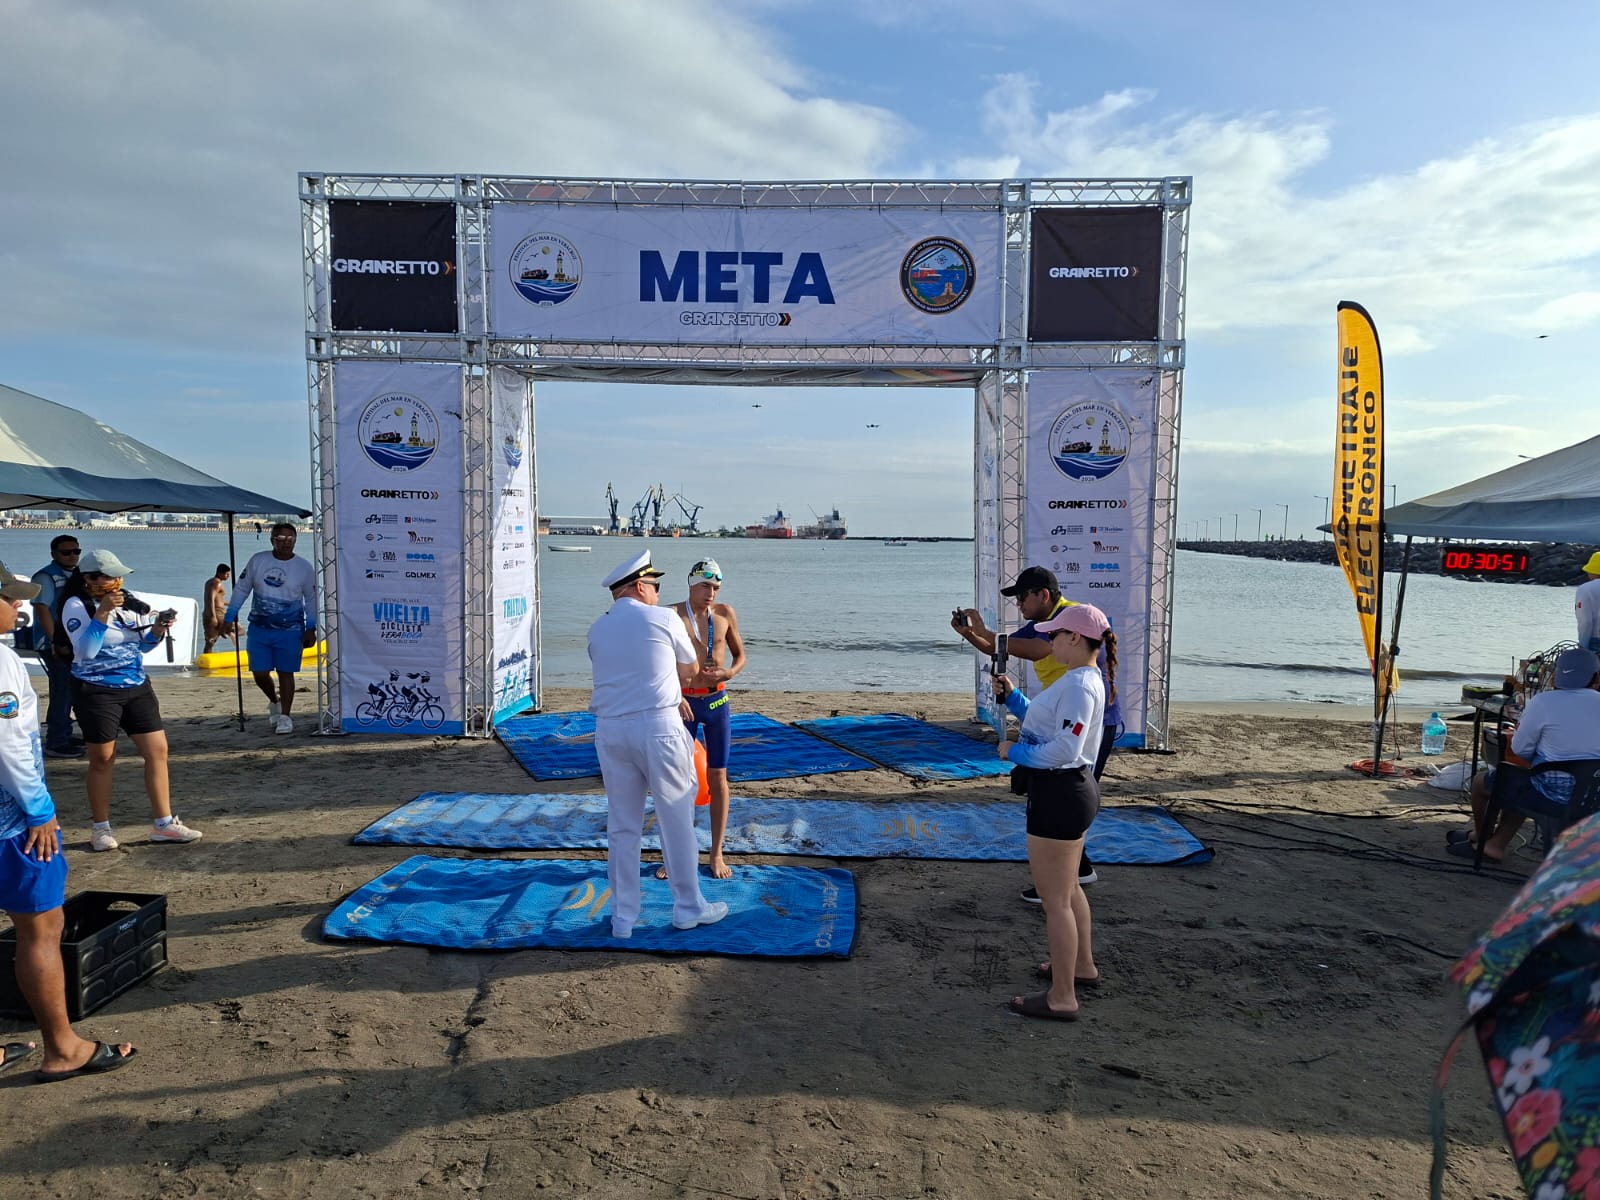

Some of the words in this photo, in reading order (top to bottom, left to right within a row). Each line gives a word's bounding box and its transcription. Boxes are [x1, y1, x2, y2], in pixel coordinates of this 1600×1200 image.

[333, 258, 440, 275] GRANRETTO
[1049, 266, 1129, 278] GRANRETTO
[639, 250, 836, 304] META
[679, 311, 780, 326] GRANRETTO
[363, 402, 380, 424] FESTIVAL
[1054, 413, 1072, 435] FESTIVAL
[360, 488, 430, 500] GRANRETTO
[1048, 499, 1118, 509] GRANRETTO
[1356, 391, 1376, 615] ELECTRÓNICO
[1445, 551, 1527, 571] 00:30:51
[405, 571, 437, 579] GOLMEX
[373, 602, 430, 626] VUELTA
[381, 622, 422, 633] CICLISTA
